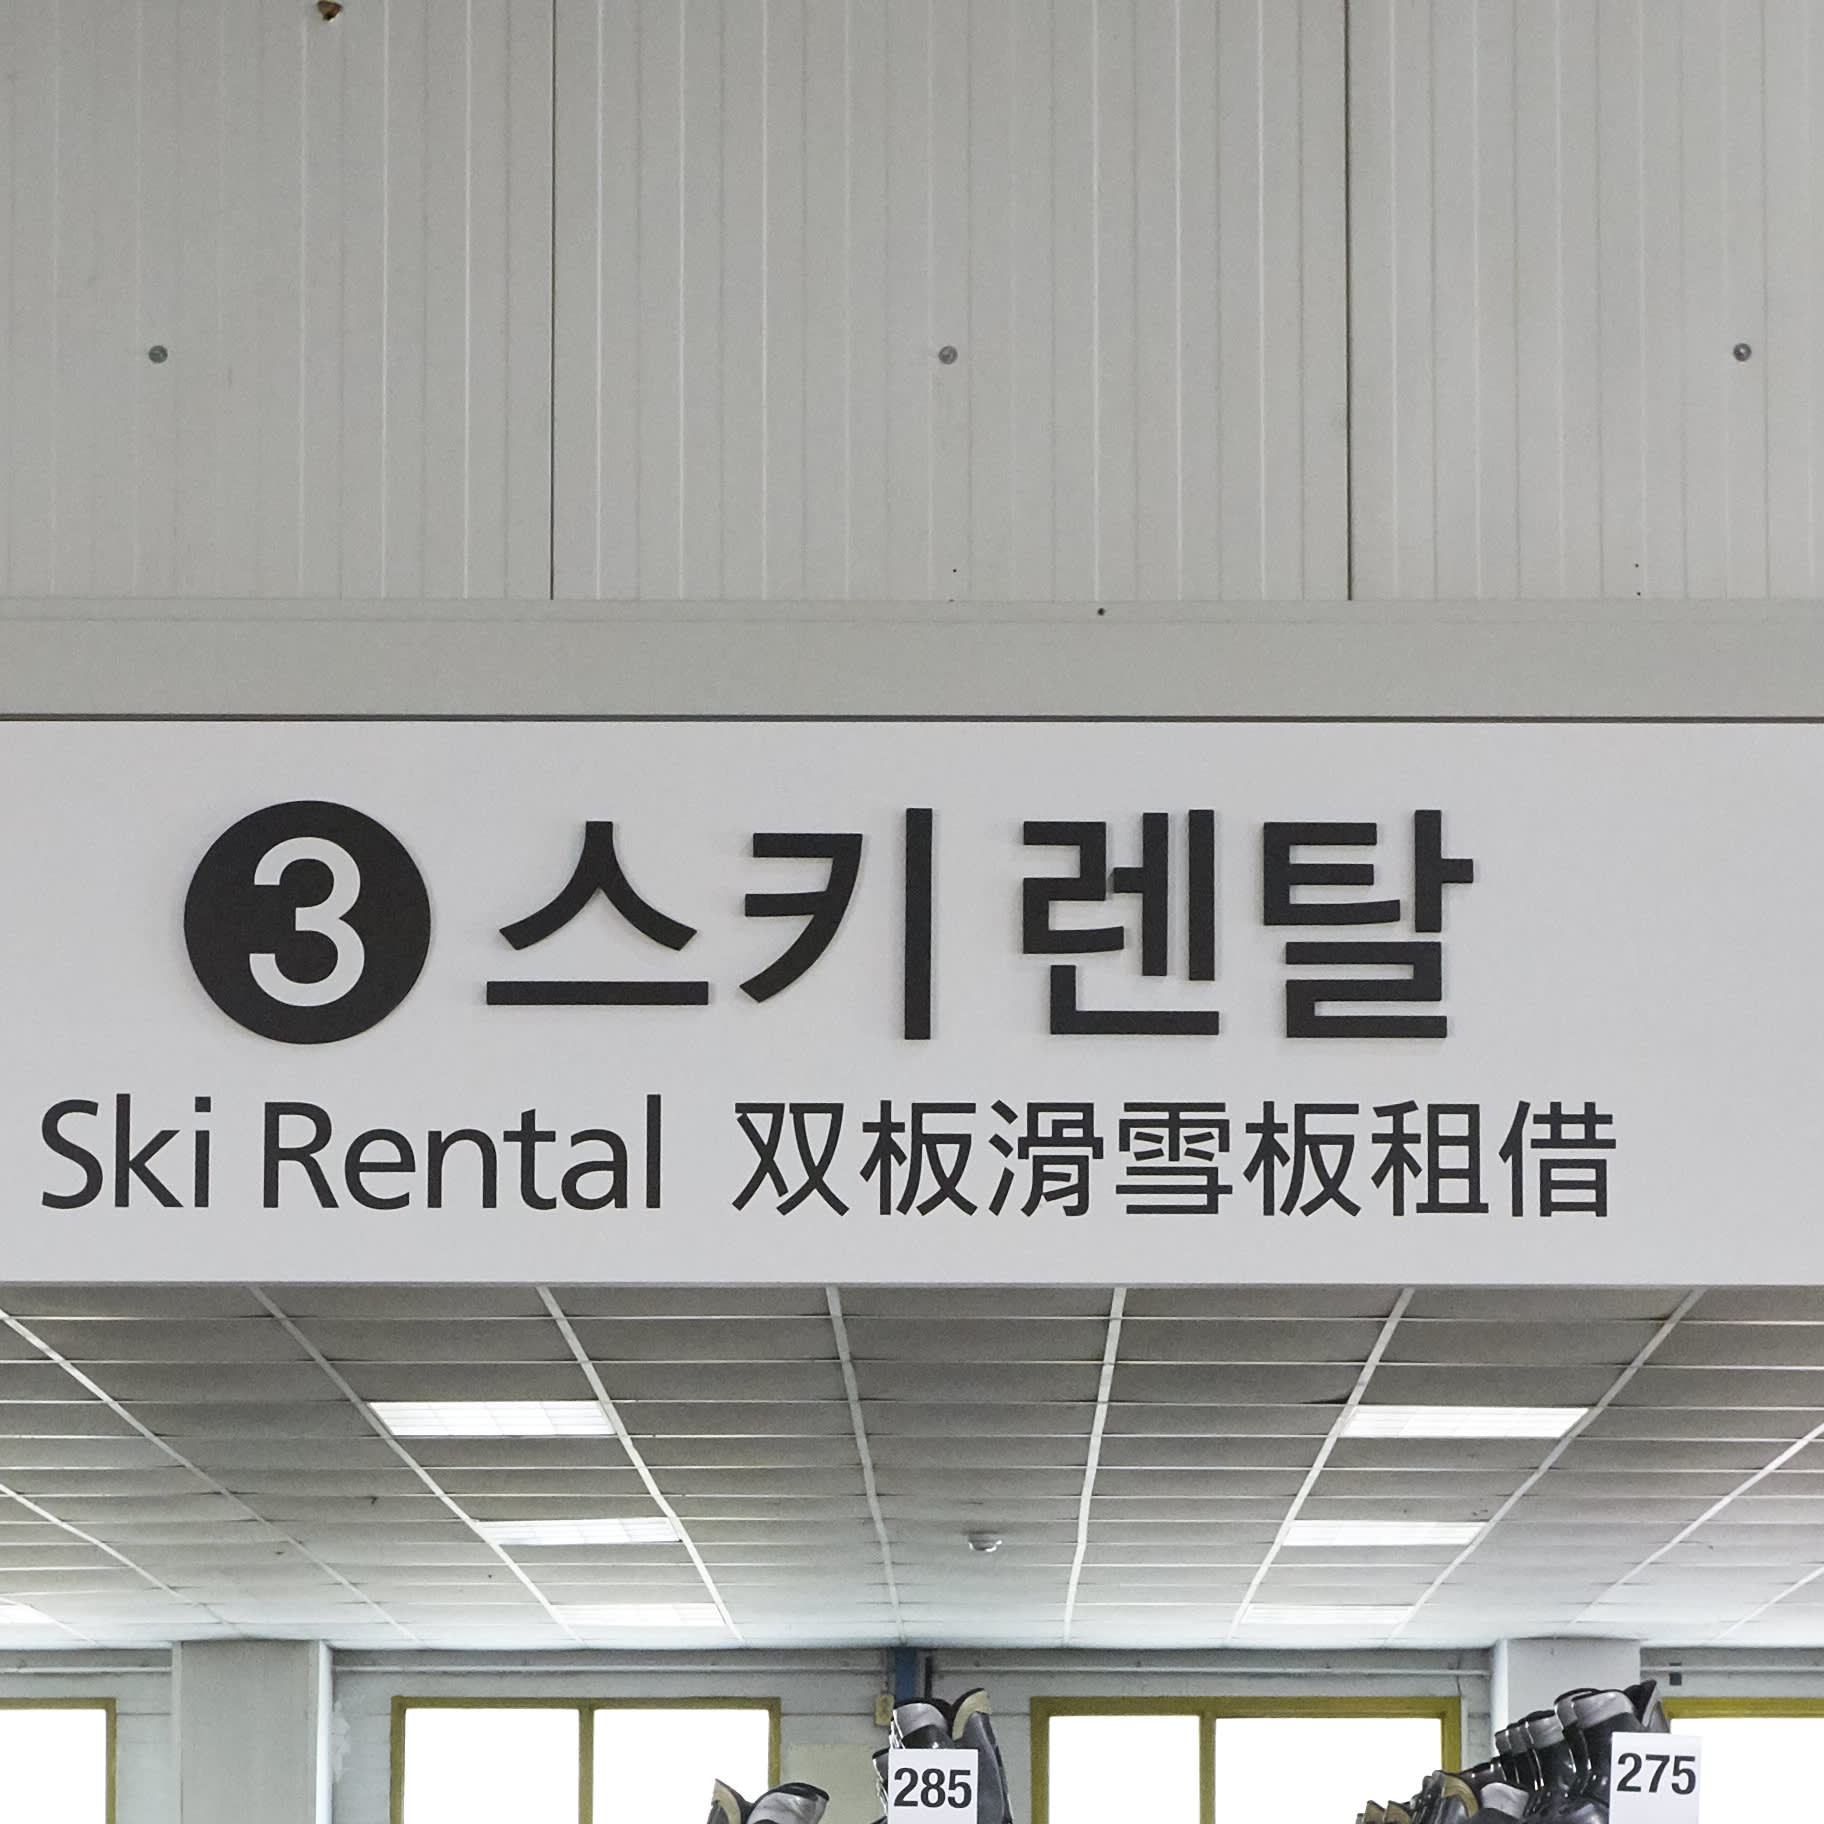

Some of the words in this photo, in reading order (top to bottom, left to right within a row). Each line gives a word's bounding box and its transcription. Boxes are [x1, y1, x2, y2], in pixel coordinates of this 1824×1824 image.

[250, 837, 364, 1006] 3
[486, 808, 933, 1040] 스키
[1022, 810, 1473, 1038] 렌탈
[42, 1094, 211, 1210] Ski
[264, 1094, 662, 1210] Rental
[732, 1100, 1616, 1218] 双板滑雪板租借
[894, 1768, 972, 1808] 285
[1617, 1753, 1695, 1794] 275
